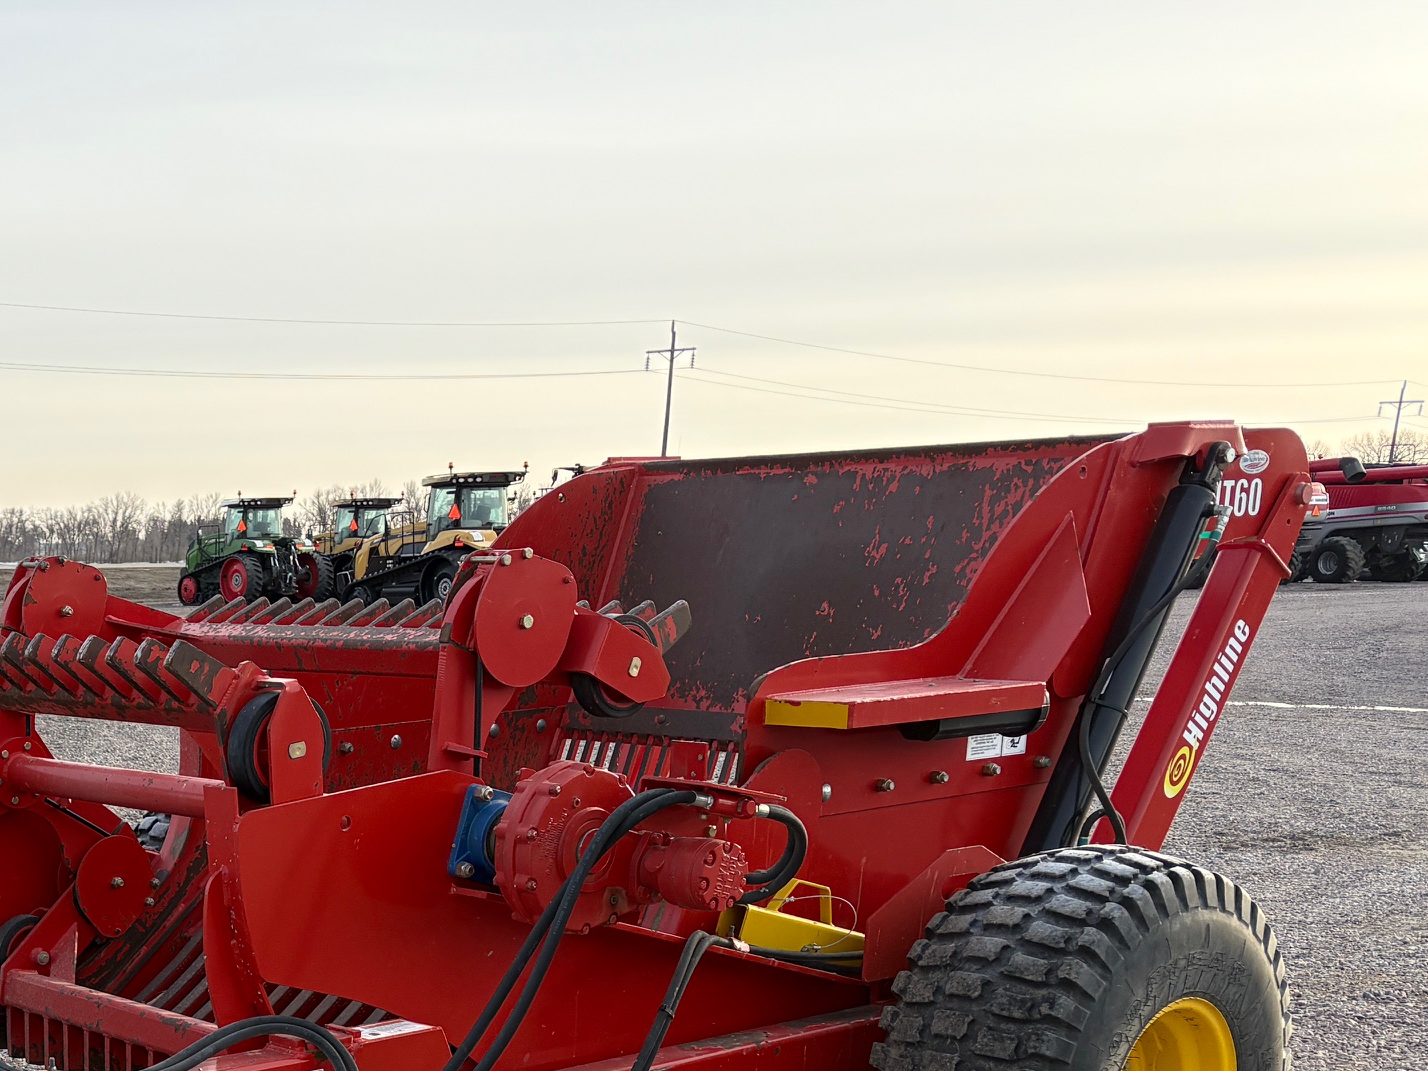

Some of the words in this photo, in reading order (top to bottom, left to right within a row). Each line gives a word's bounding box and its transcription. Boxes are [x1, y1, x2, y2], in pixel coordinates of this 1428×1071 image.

[1182, 619, 1250, 750] Highline
[713, 855, 729, 896] STATOR
[721, 856, 738, 899] ROLLER
